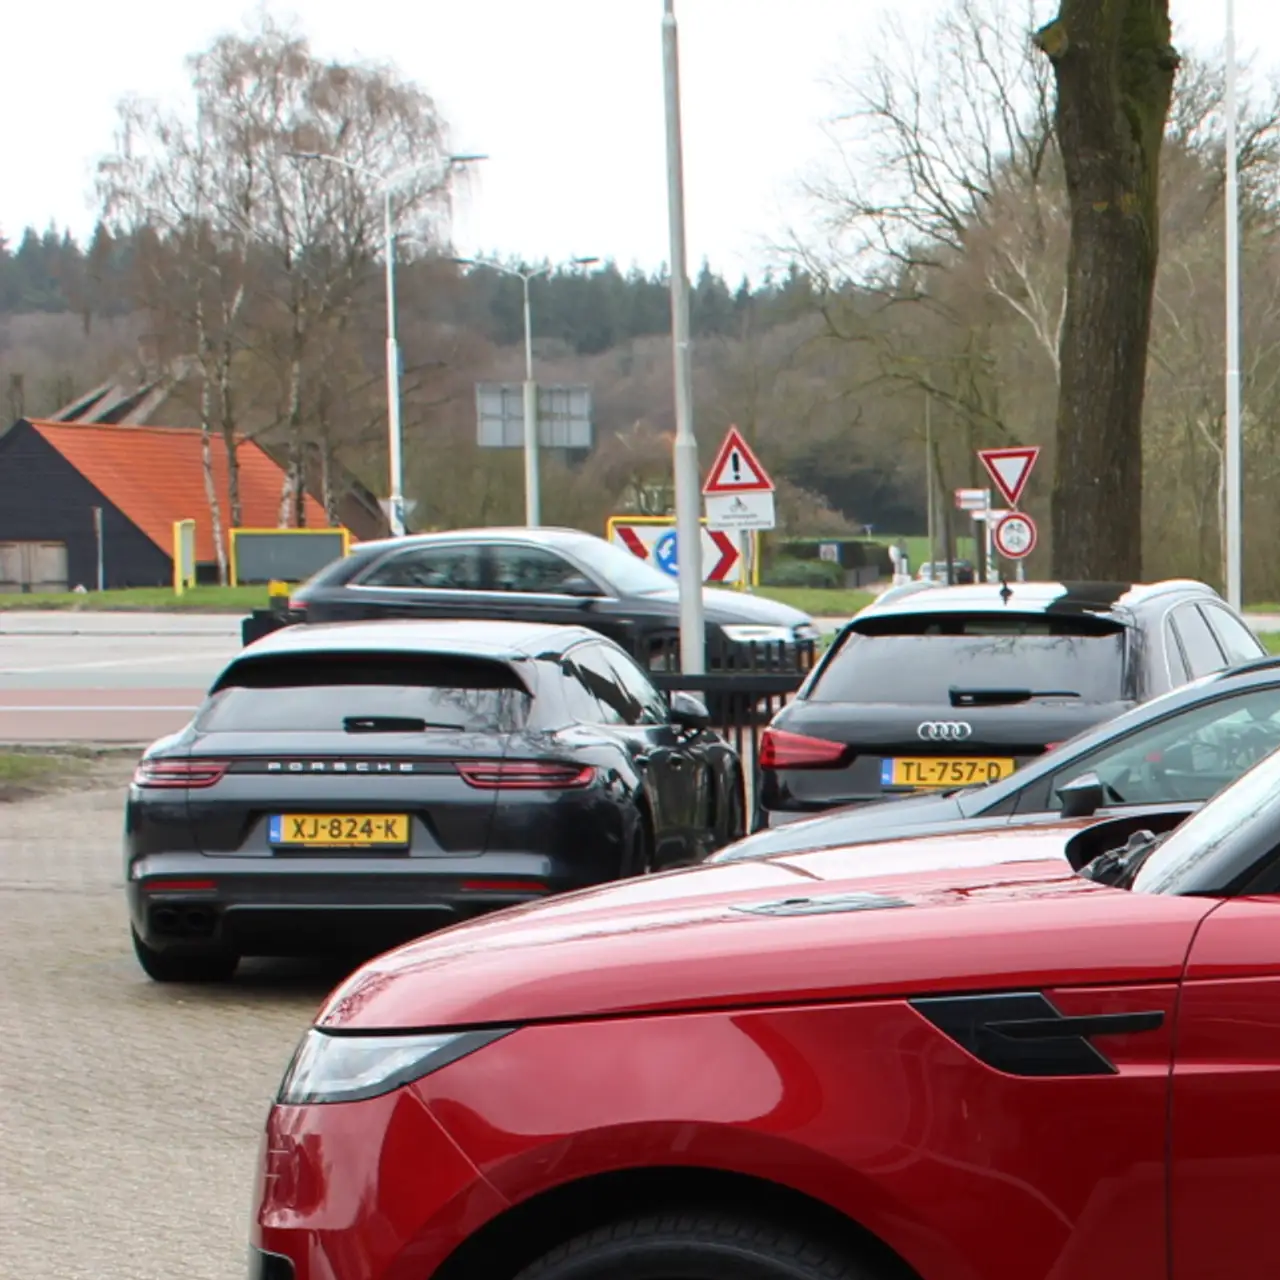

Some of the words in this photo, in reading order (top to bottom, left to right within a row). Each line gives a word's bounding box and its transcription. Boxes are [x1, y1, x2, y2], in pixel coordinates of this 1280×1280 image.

[267, 761, 413, 771] PORSCHE
[902, 761, 1001, 782] TL-757-D
[292, 818, 398, 839] XJ-824-K
